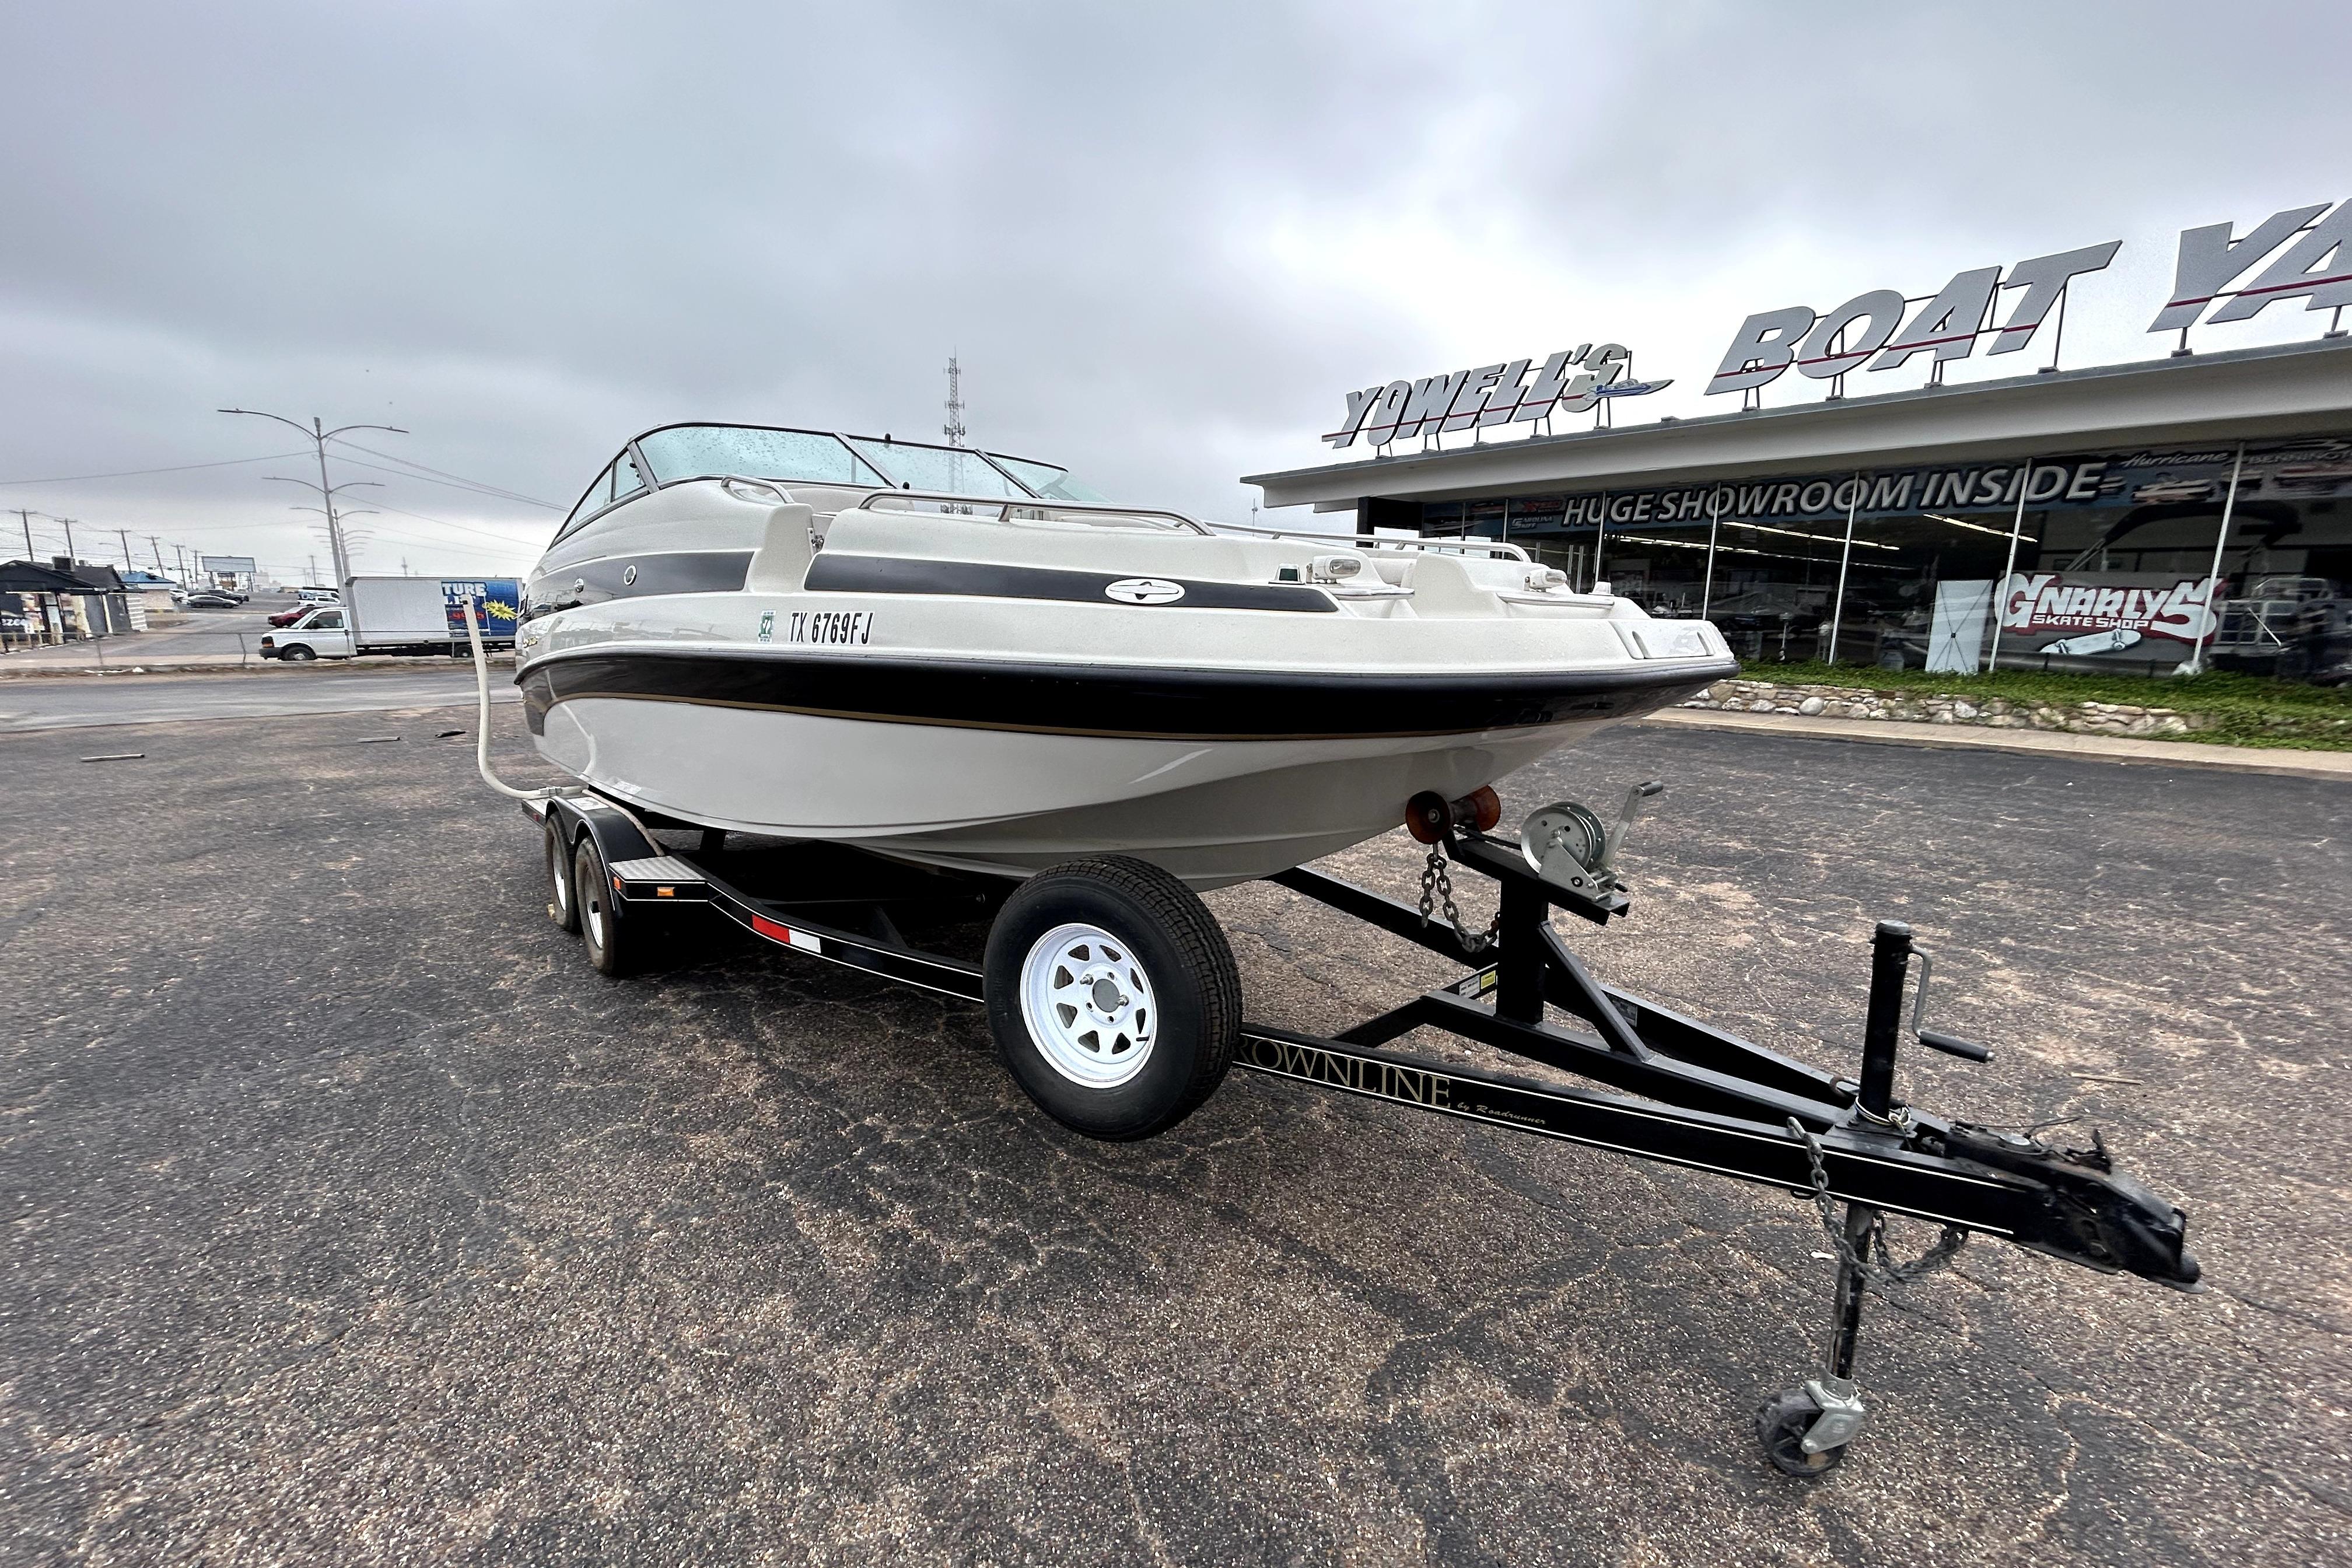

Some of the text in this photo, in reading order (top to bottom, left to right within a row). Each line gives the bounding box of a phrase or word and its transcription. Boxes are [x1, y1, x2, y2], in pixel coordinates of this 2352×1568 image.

[1322, 344, 1629, 449] YOWELL'S
[1704, 240, 2122, 396] BOAT
[2119, 453, 2228, 467] Hurricane
[1563, 462, 2107, 525] HUGE SHOWROOM INSIDE
[1994, 573, 2224, 639] GNARLYS
[790, 612, 873, 644] TX 6769FJ
[2032, 615, 2148, 631] SKATE SHOP
[1457, 1101, 1470, 1112] by
[1476, 1104, 1546, 1125] Roadrunner
